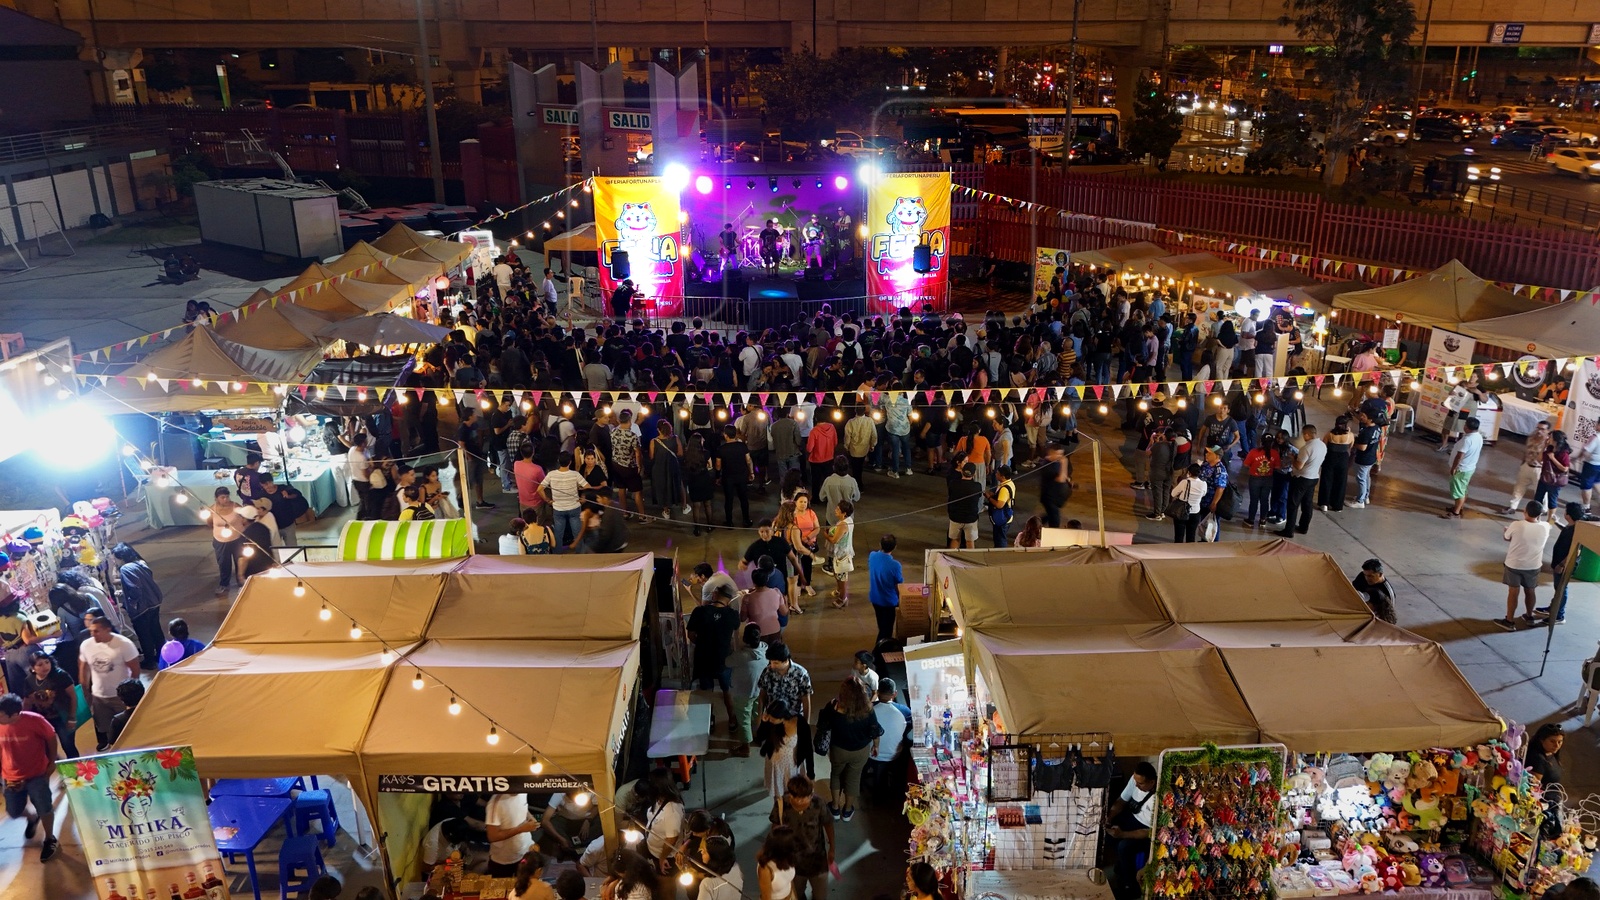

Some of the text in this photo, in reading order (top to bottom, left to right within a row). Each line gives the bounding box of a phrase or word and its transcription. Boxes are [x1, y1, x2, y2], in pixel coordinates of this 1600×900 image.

[612, 113, 650, 129] SALID
[423, 776, 510, 792] GRATIS
[523, 781, 588, 789] ROMPECABEZAS
[107, 815, 185, 840] MITIKA
[168, 831, 191, 840] PISCO
